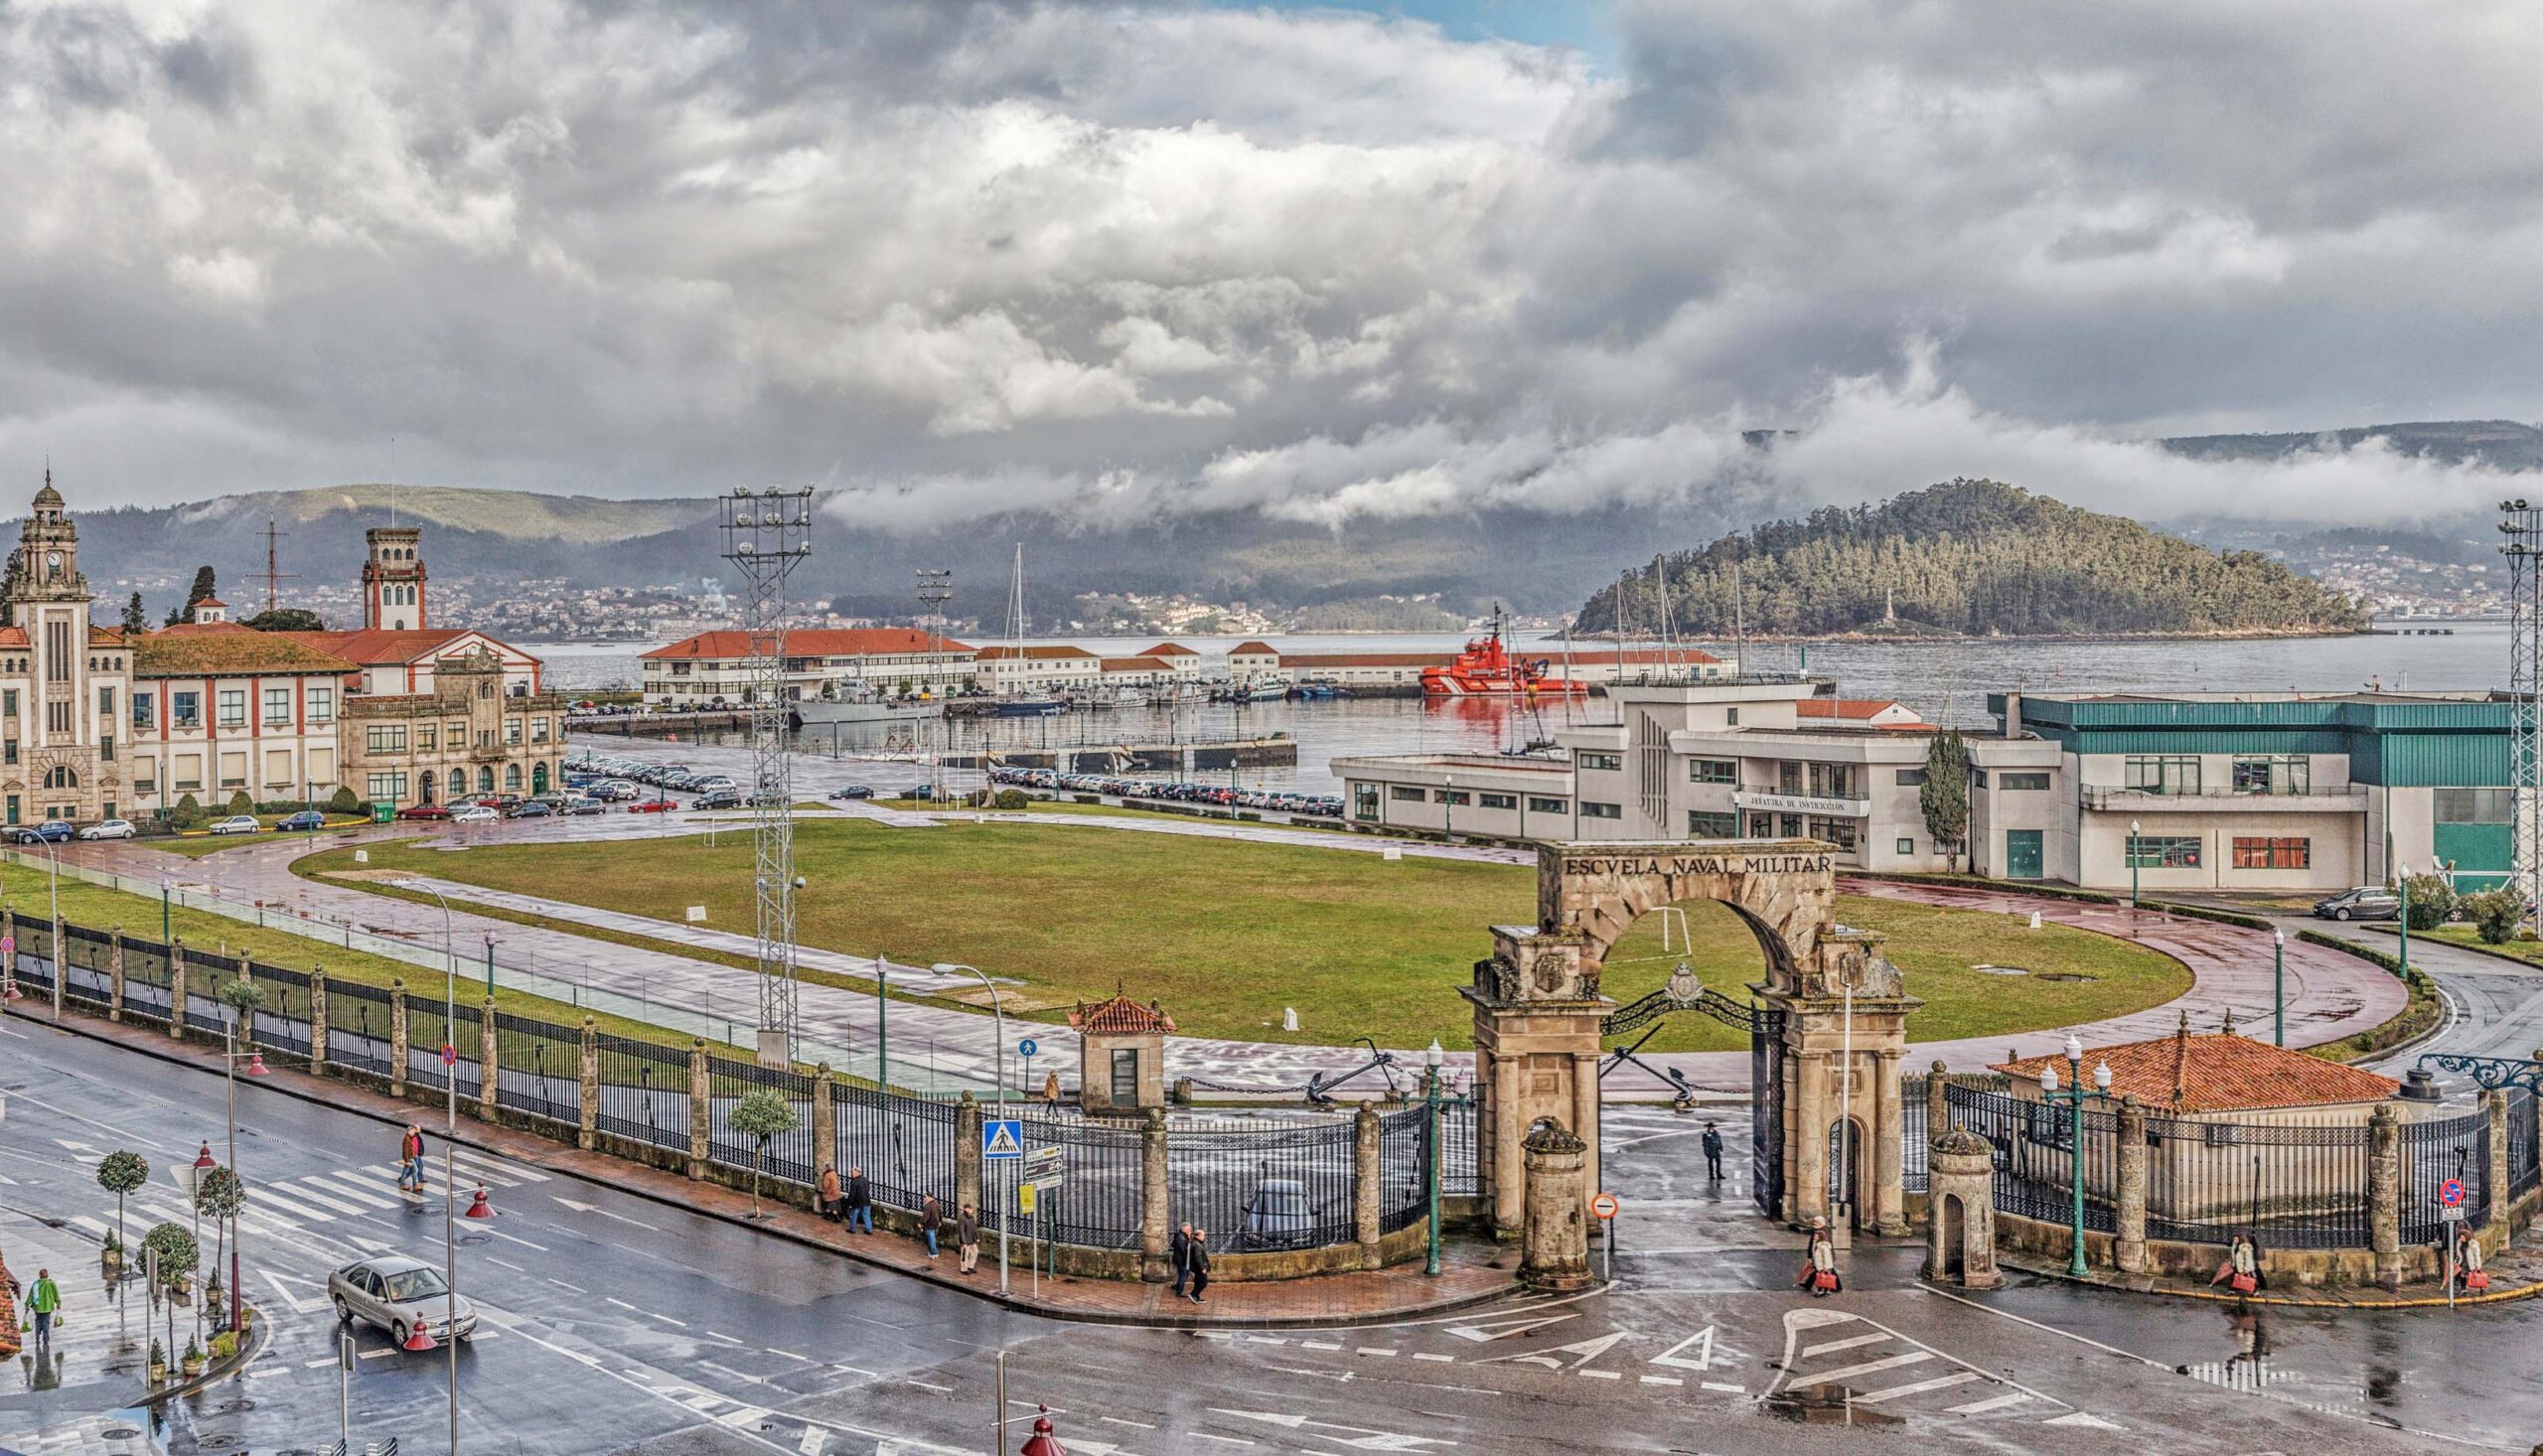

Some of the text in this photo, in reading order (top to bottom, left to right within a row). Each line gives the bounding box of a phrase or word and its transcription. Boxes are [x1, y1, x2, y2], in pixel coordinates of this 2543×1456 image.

[1750, 798, 1783, 806] JEFATURA
[1799, 801, 1845, 811] INSTRUCCIÓN
[1566, 857, 1831, 876] ESCVELA NAVAL MILITAR
